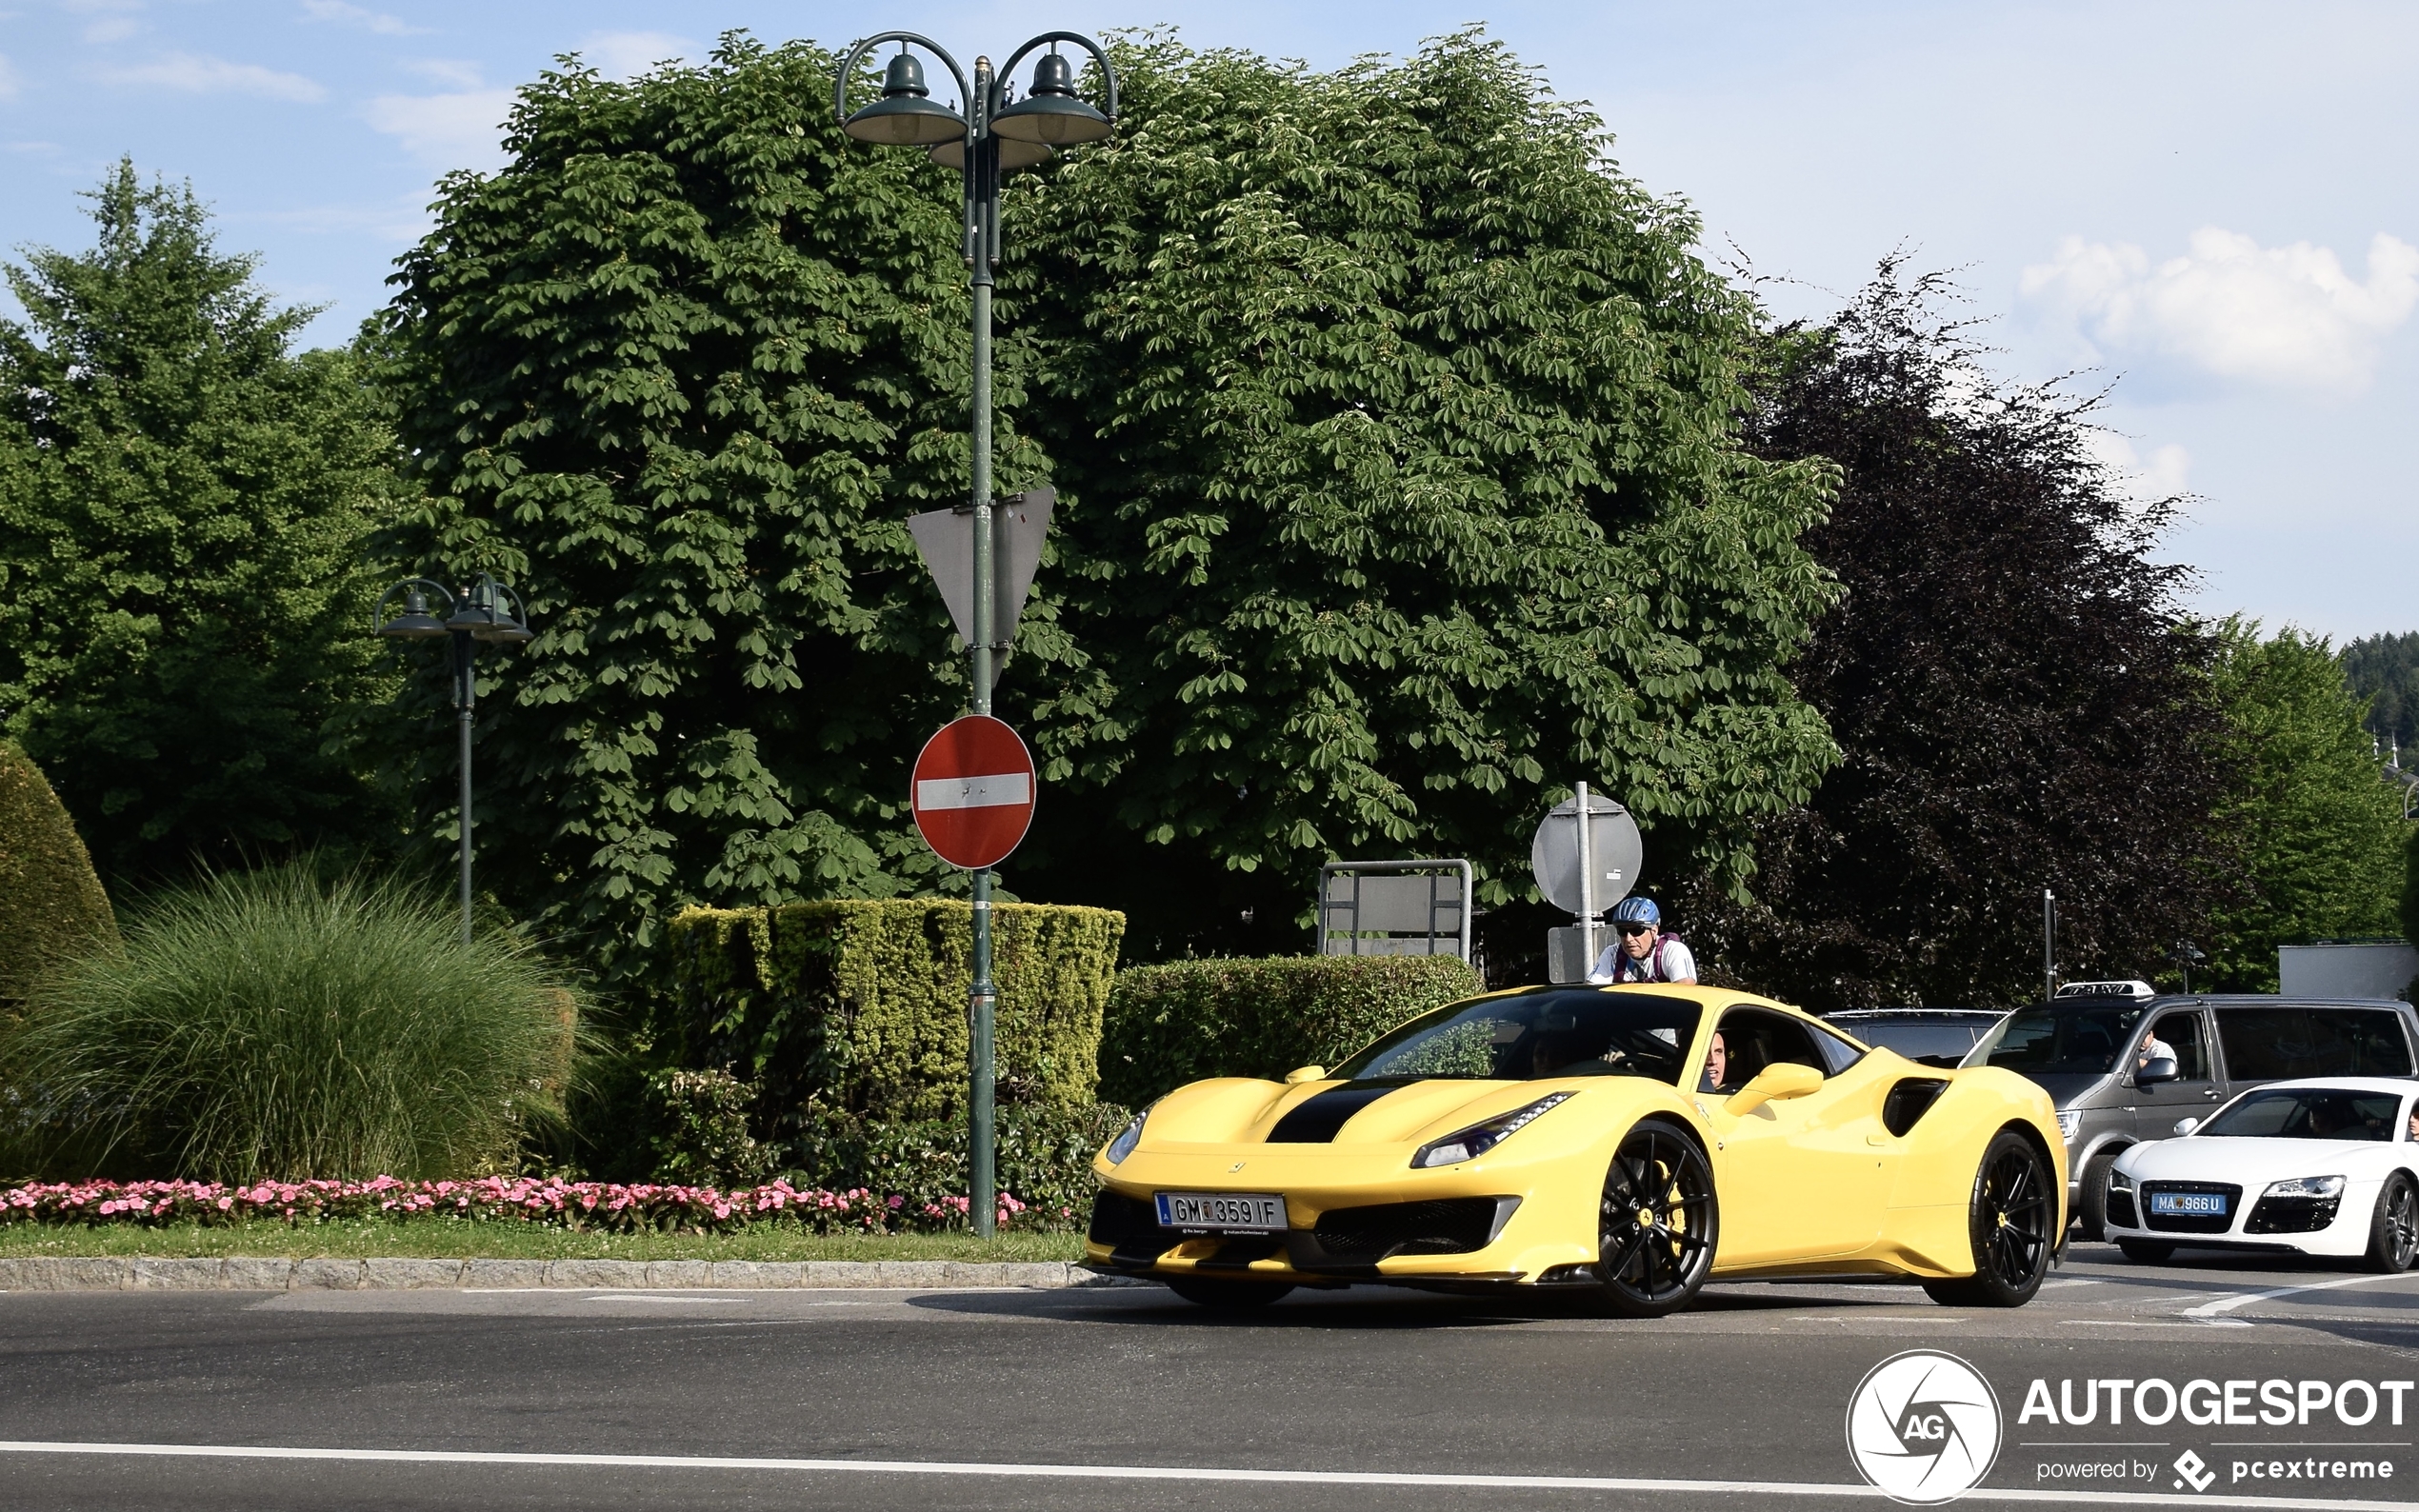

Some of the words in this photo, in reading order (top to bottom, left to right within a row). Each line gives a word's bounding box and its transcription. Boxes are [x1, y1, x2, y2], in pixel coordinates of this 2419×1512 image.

[2069, 984, 2126, 995] TAXI
[1175, 1198, 1203, 1222] GM
[1215, 1199, 1253, 1223] 359
[1256, 1200, 1275, 1224] IF
[2159, 1196, 2175, 1210] MA
[2185, 1197, 2209, 1211] 966
[2210, 1197, 2219, 1211] U
